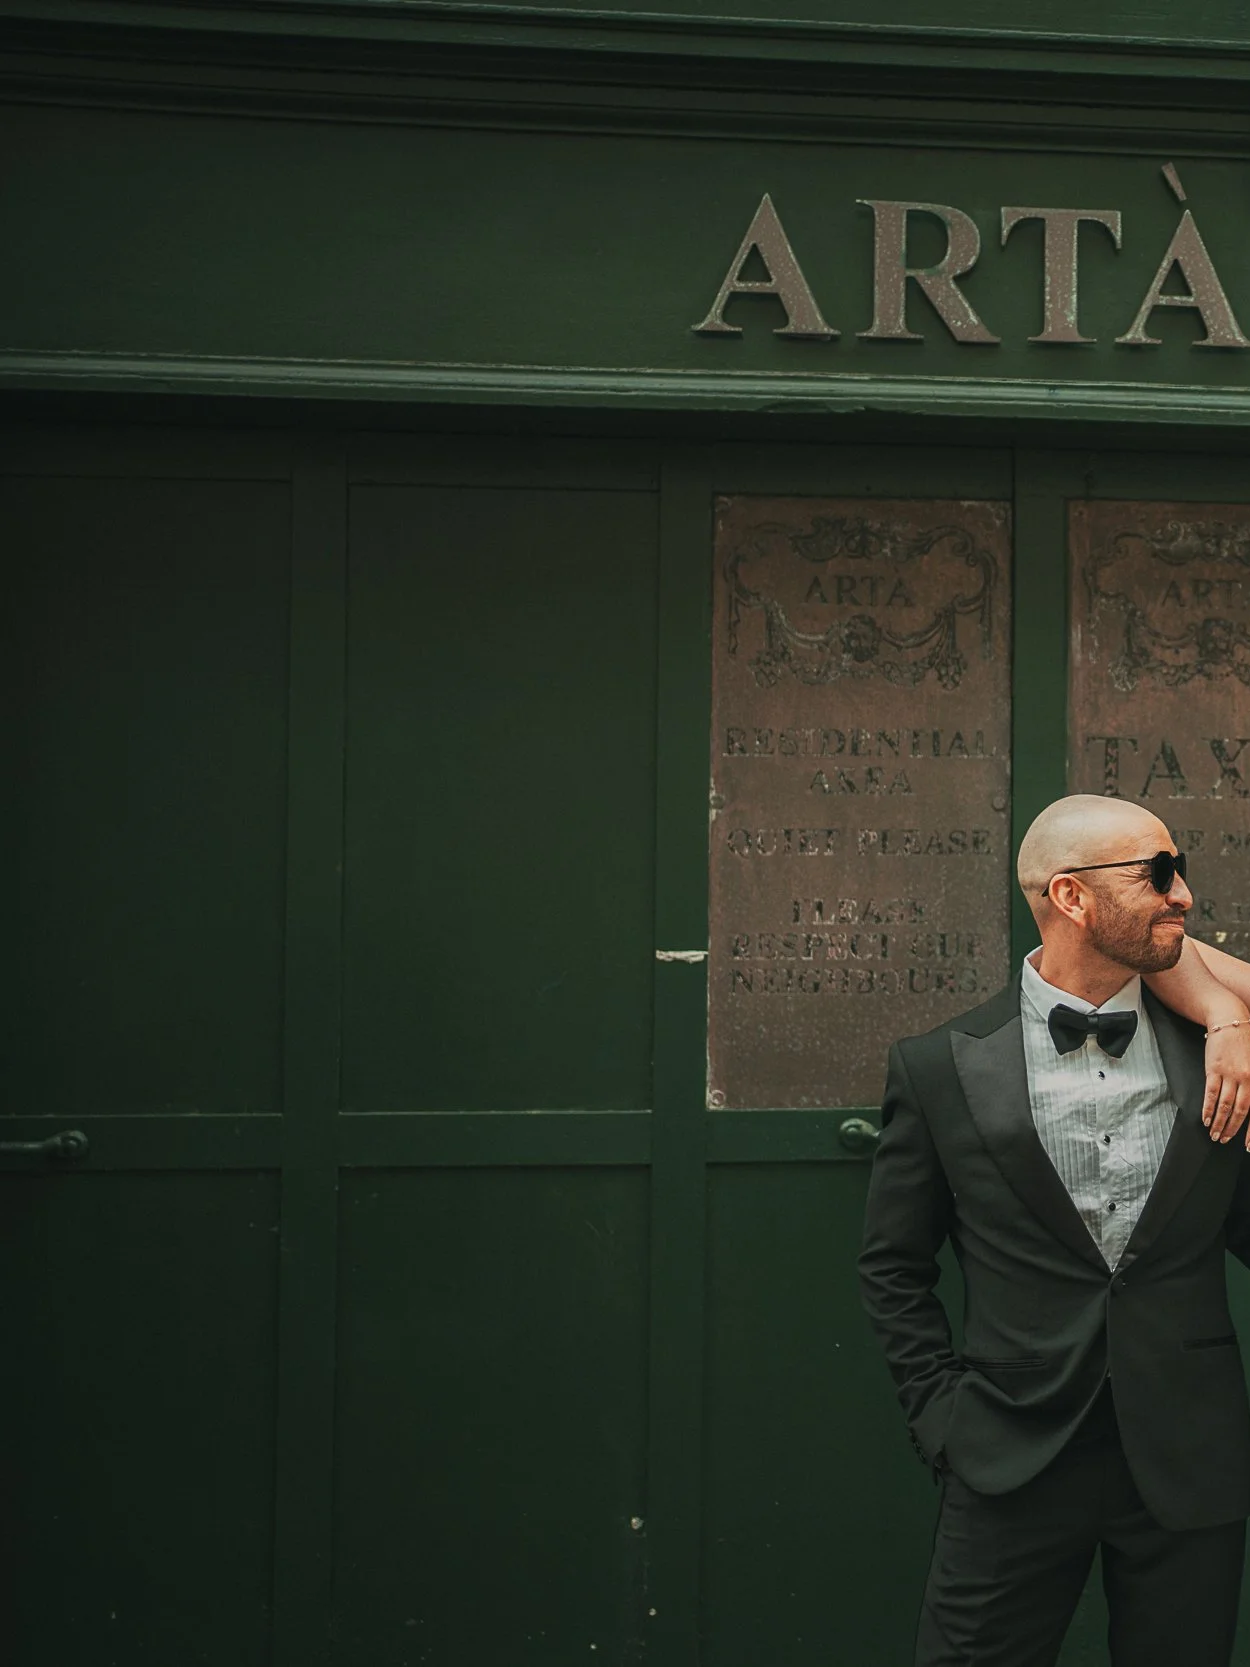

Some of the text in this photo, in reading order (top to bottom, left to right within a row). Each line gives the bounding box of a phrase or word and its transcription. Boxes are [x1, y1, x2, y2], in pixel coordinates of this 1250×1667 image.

[721, 727, 998, 758] RESIDENTIAL
[808, 765, 916, 795] AREA
[726, 827, 994, 859] QUIET PLEASE
[792, 895, 931, 926] PLEASE
[730, 931, 896, 962] RESPECT
